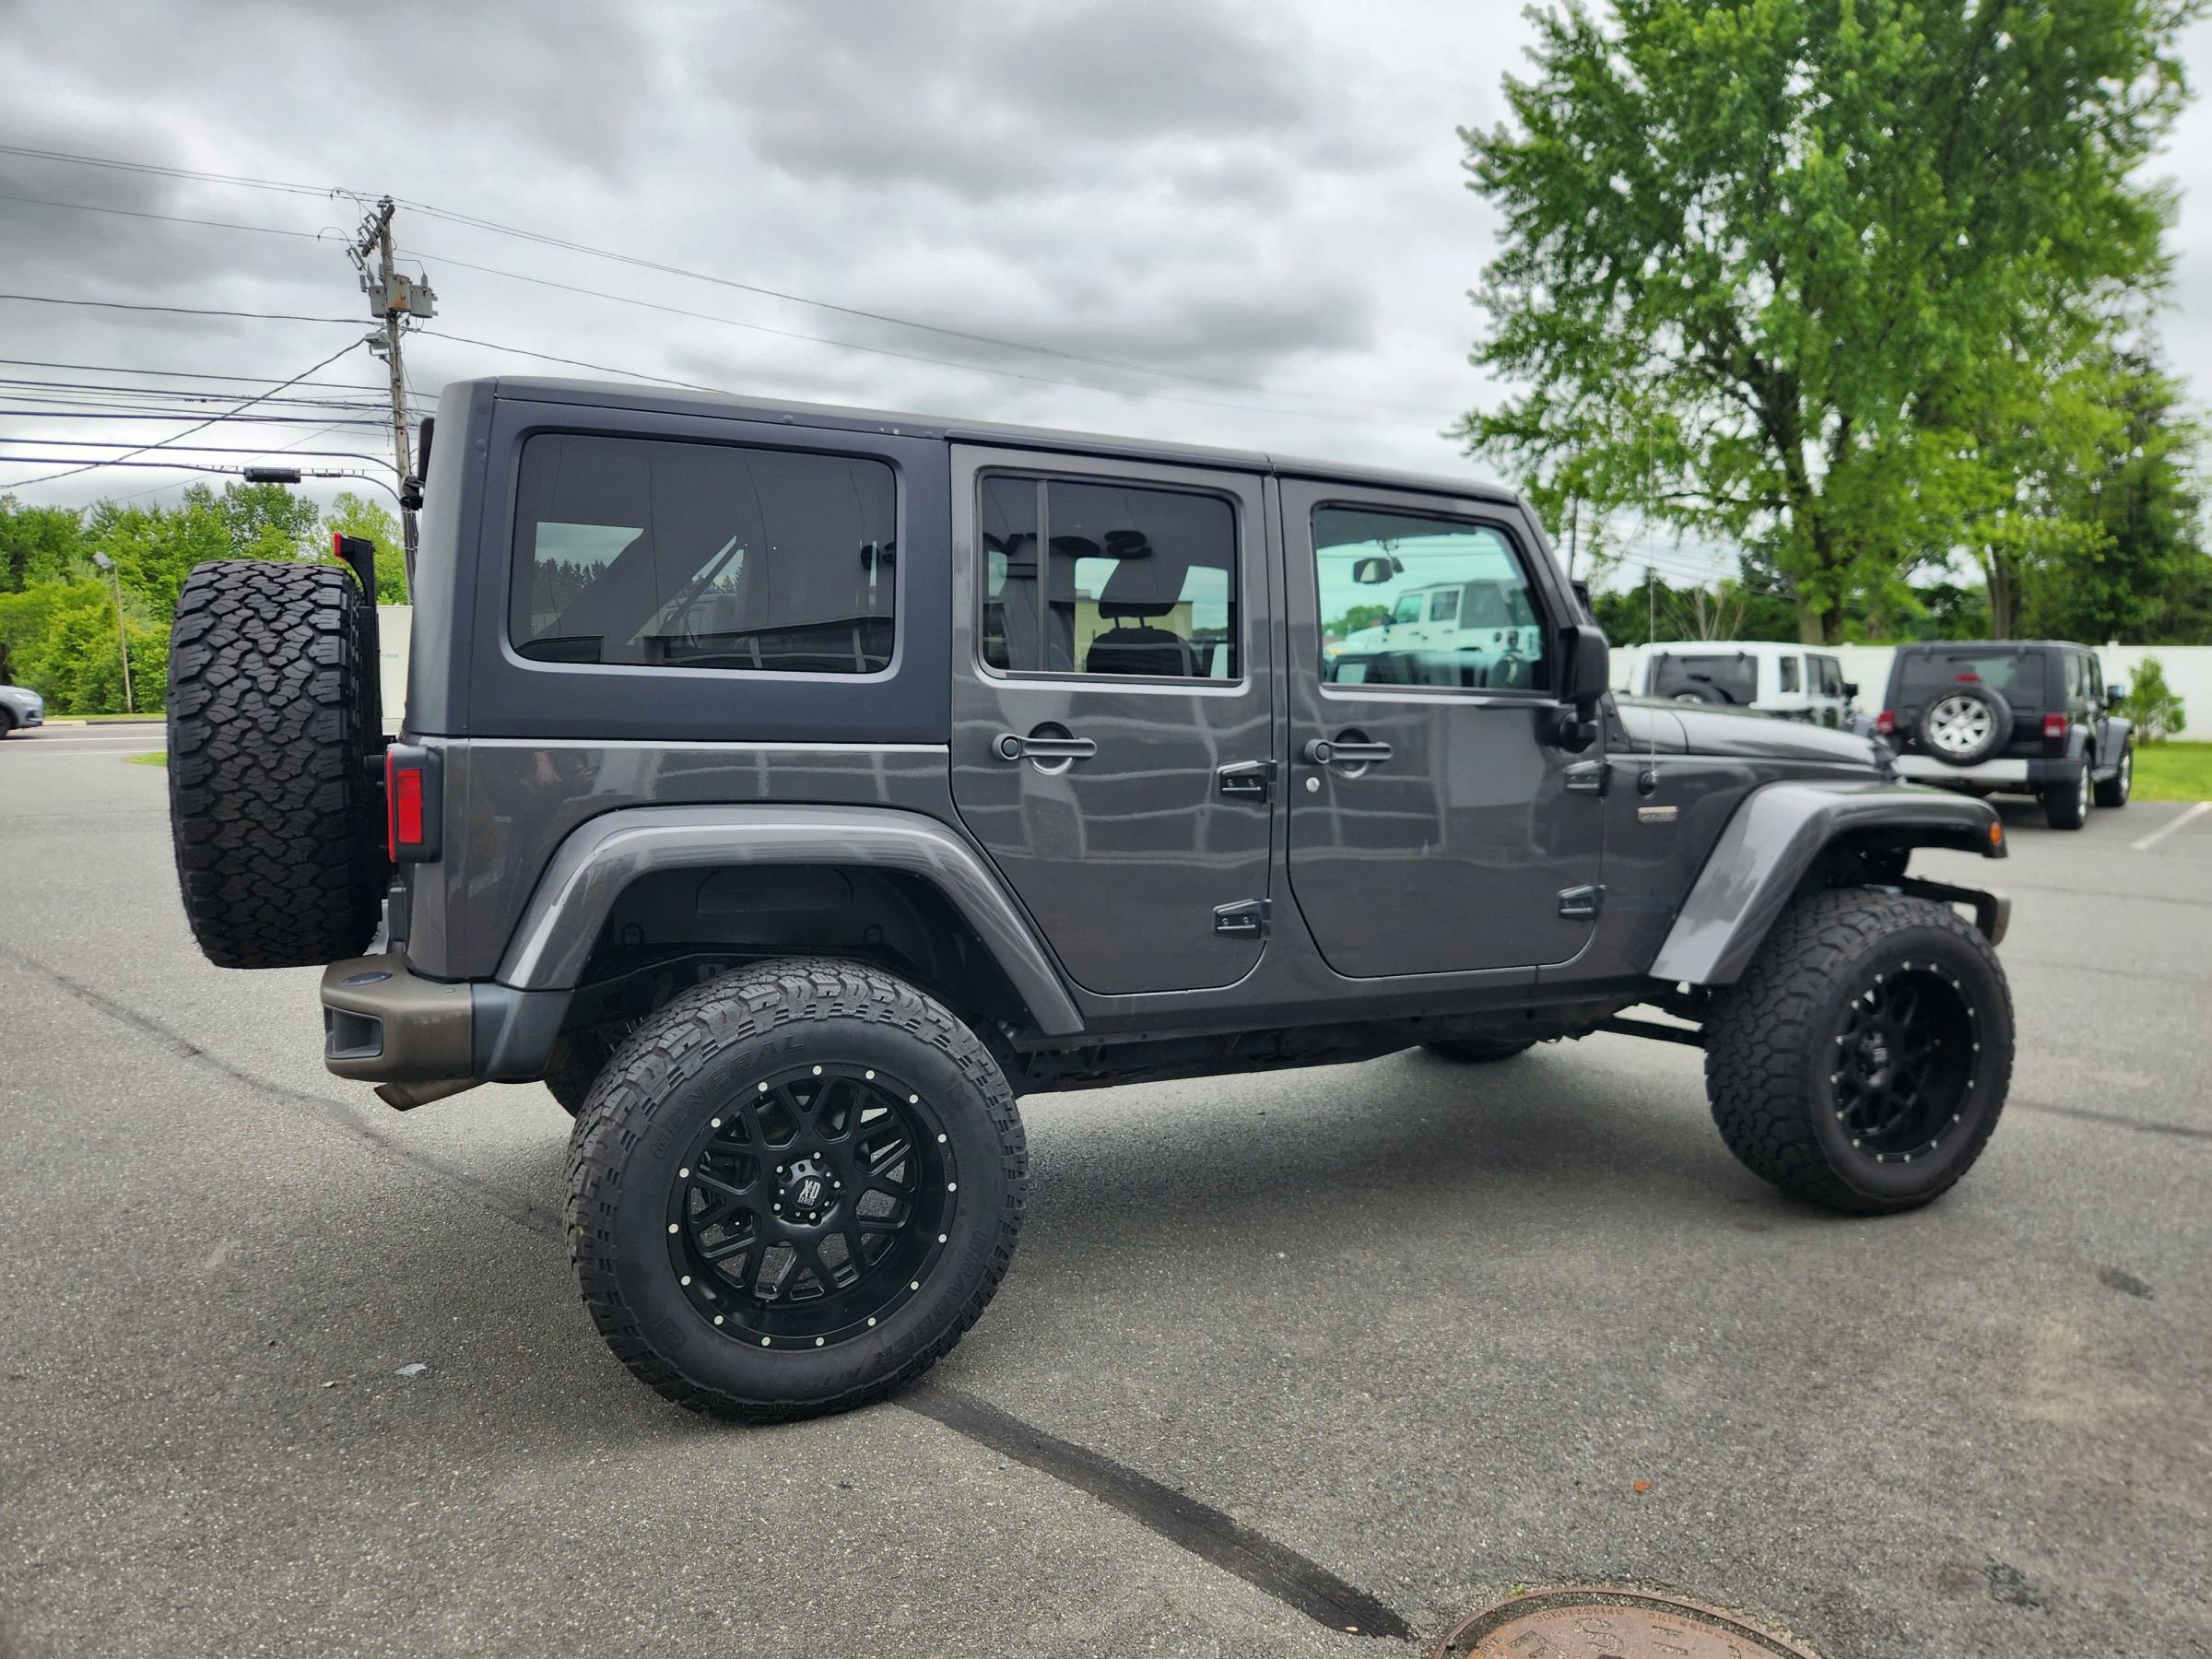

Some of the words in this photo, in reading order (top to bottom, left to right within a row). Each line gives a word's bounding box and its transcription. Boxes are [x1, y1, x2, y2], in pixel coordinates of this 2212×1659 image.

[650, 1035, 805, 1158] GENERAL
[797, 1196, 816, 1206] SERIES
[799, 1180, 821, 1199] XD
[873, 1229, 987, 1366] GRABBER
